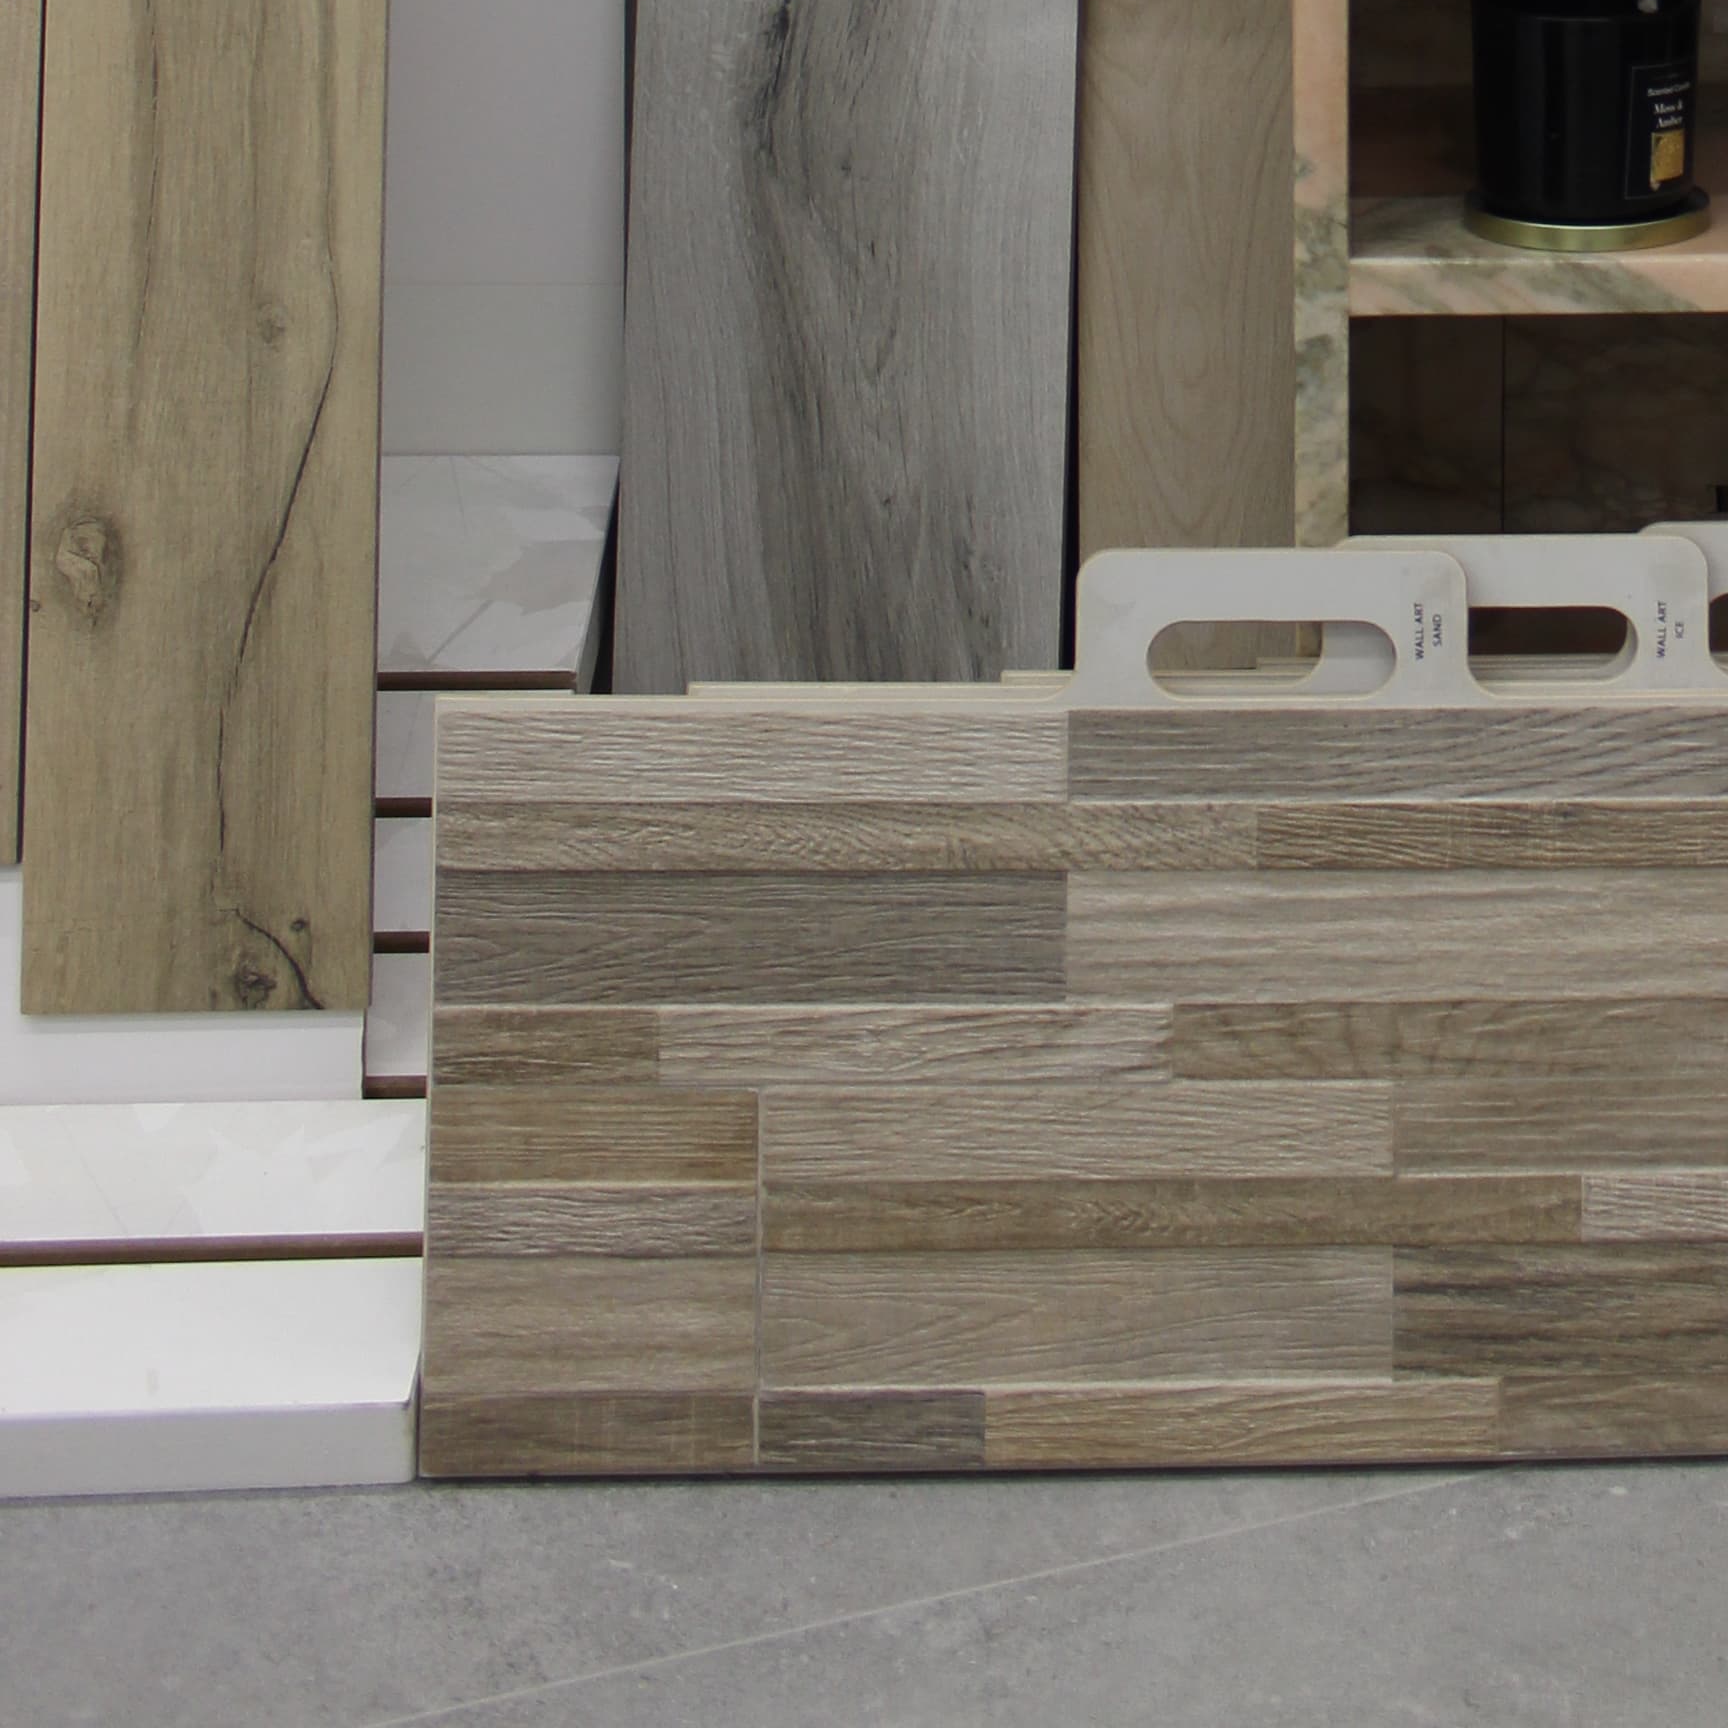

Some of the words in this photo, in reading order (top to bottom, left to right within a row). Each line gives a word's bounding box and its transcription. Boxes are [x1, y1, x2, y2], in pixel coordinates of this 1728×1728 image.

[1413, 602, 1424, 626] ART
[1657, 601, 1667, 623] ART
[1415, 627, 1425, 661] WALL
[1432, 613, 1442, 647] SAND
[1656, 626, 1667, 659] WALL
[1675, 621, 1685, 639] ICE
